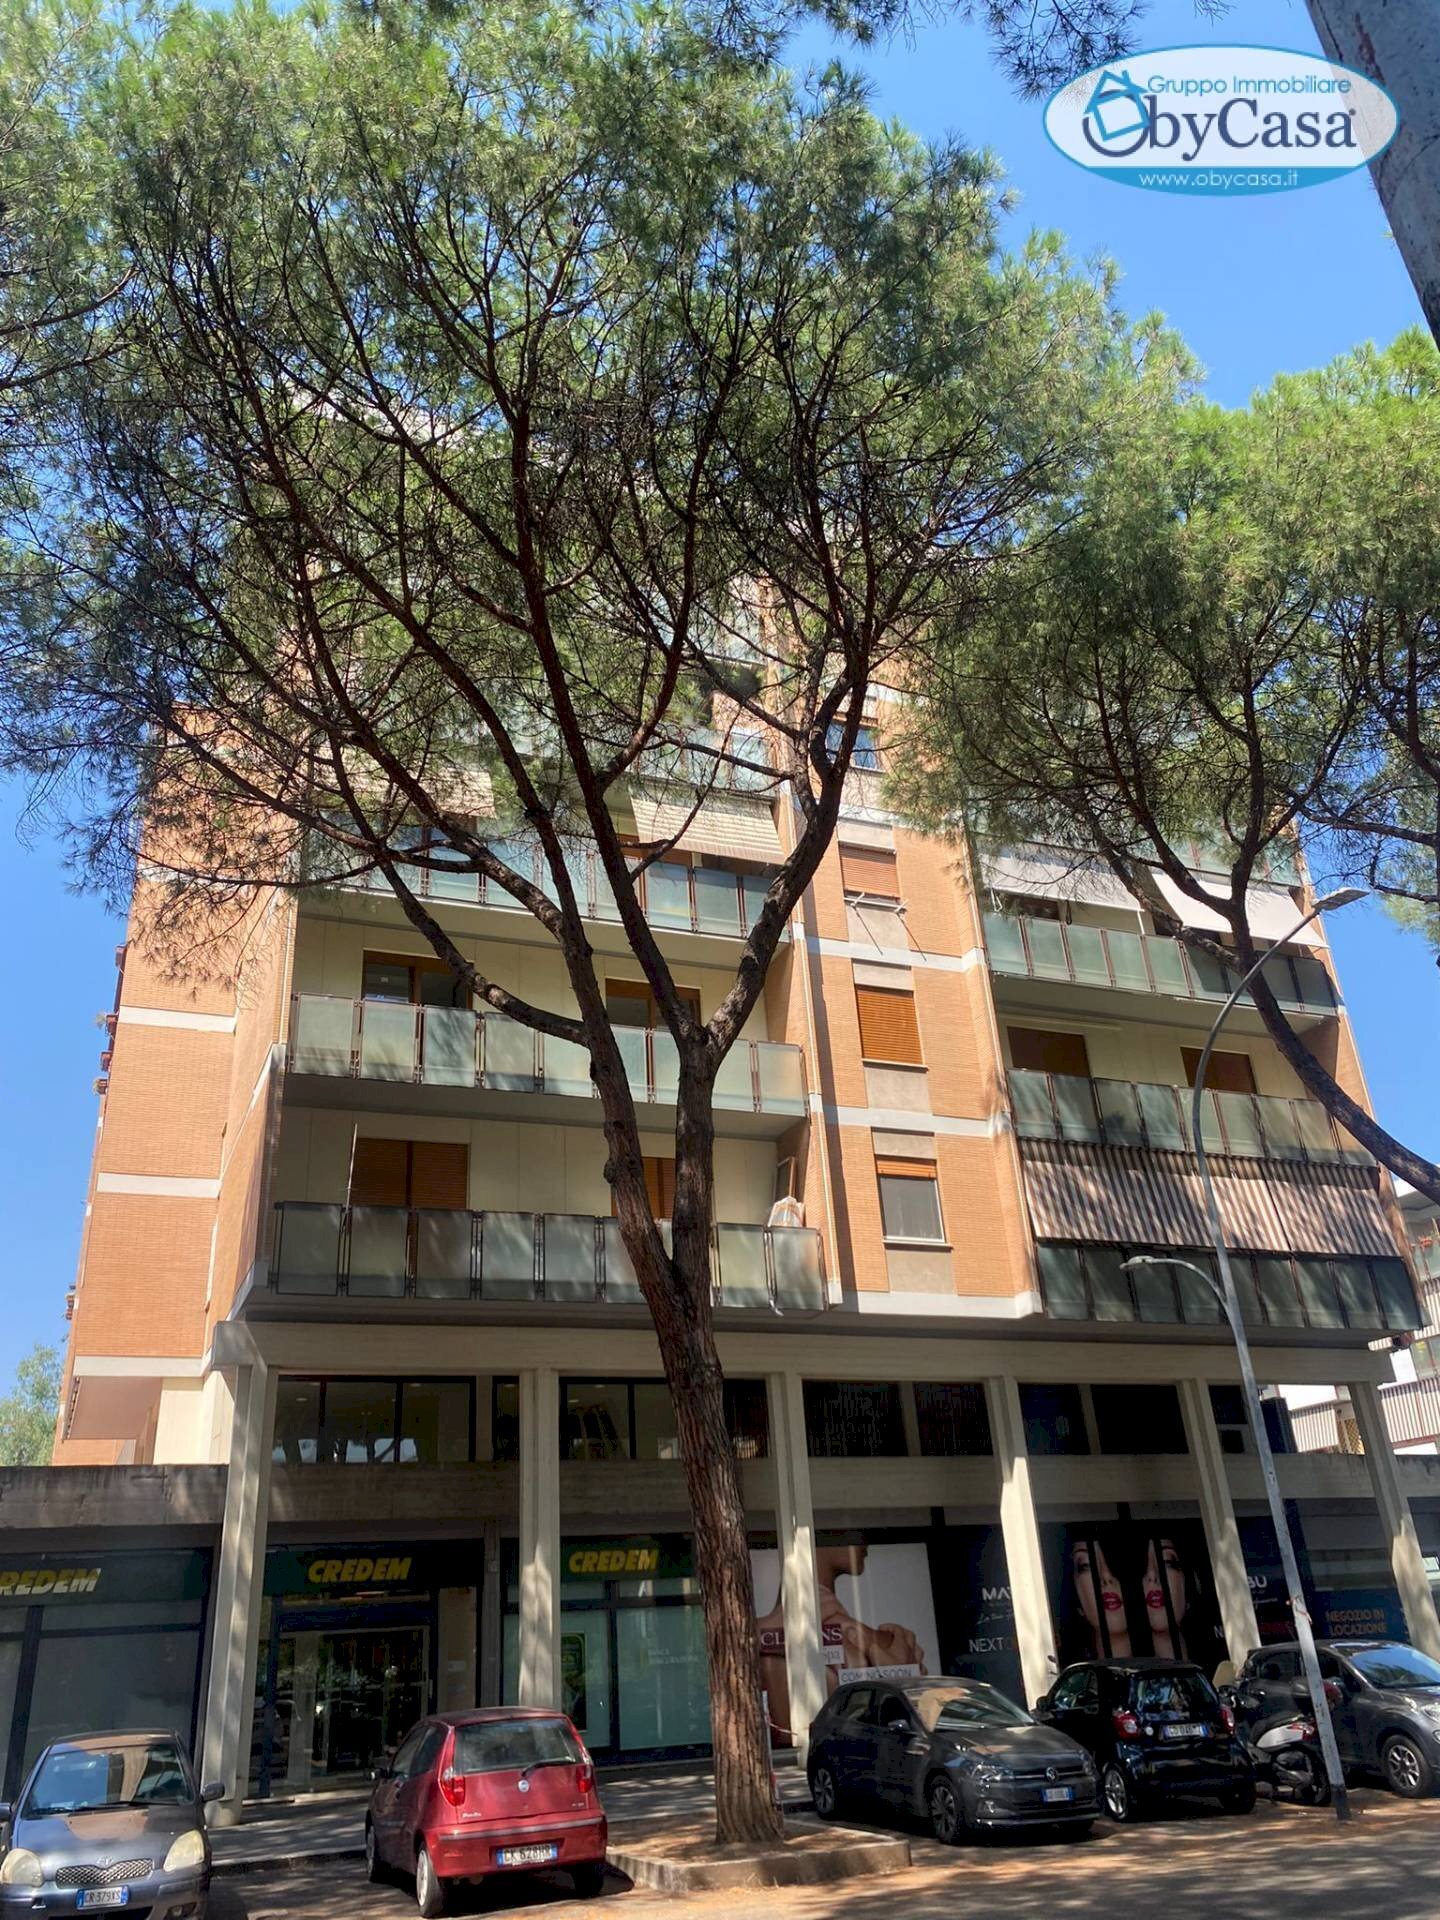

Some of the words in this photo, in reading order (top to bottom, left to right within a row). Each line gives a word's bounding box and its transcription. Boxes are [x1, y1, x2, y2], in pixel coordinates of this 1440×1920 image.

[567, 1548, 660, 1573] CREDEM
[307, 1557, 413, 1583] CREDEM
[0, 1567, 101, 1596] REDEM
[1247, 1575, 1268, 1589] BU
[981, 1586, 1011, 1601] MA
[1325, 1609, 1372, 1622] NEGOZIO
[1373, 1608, 1385, 1620] IN
[1329, 1622, 1388, 1637] LOCAZIONE
[968, 1637, 1004, 1653] NEXT
[883, 1668, 912, 1679] SOON
